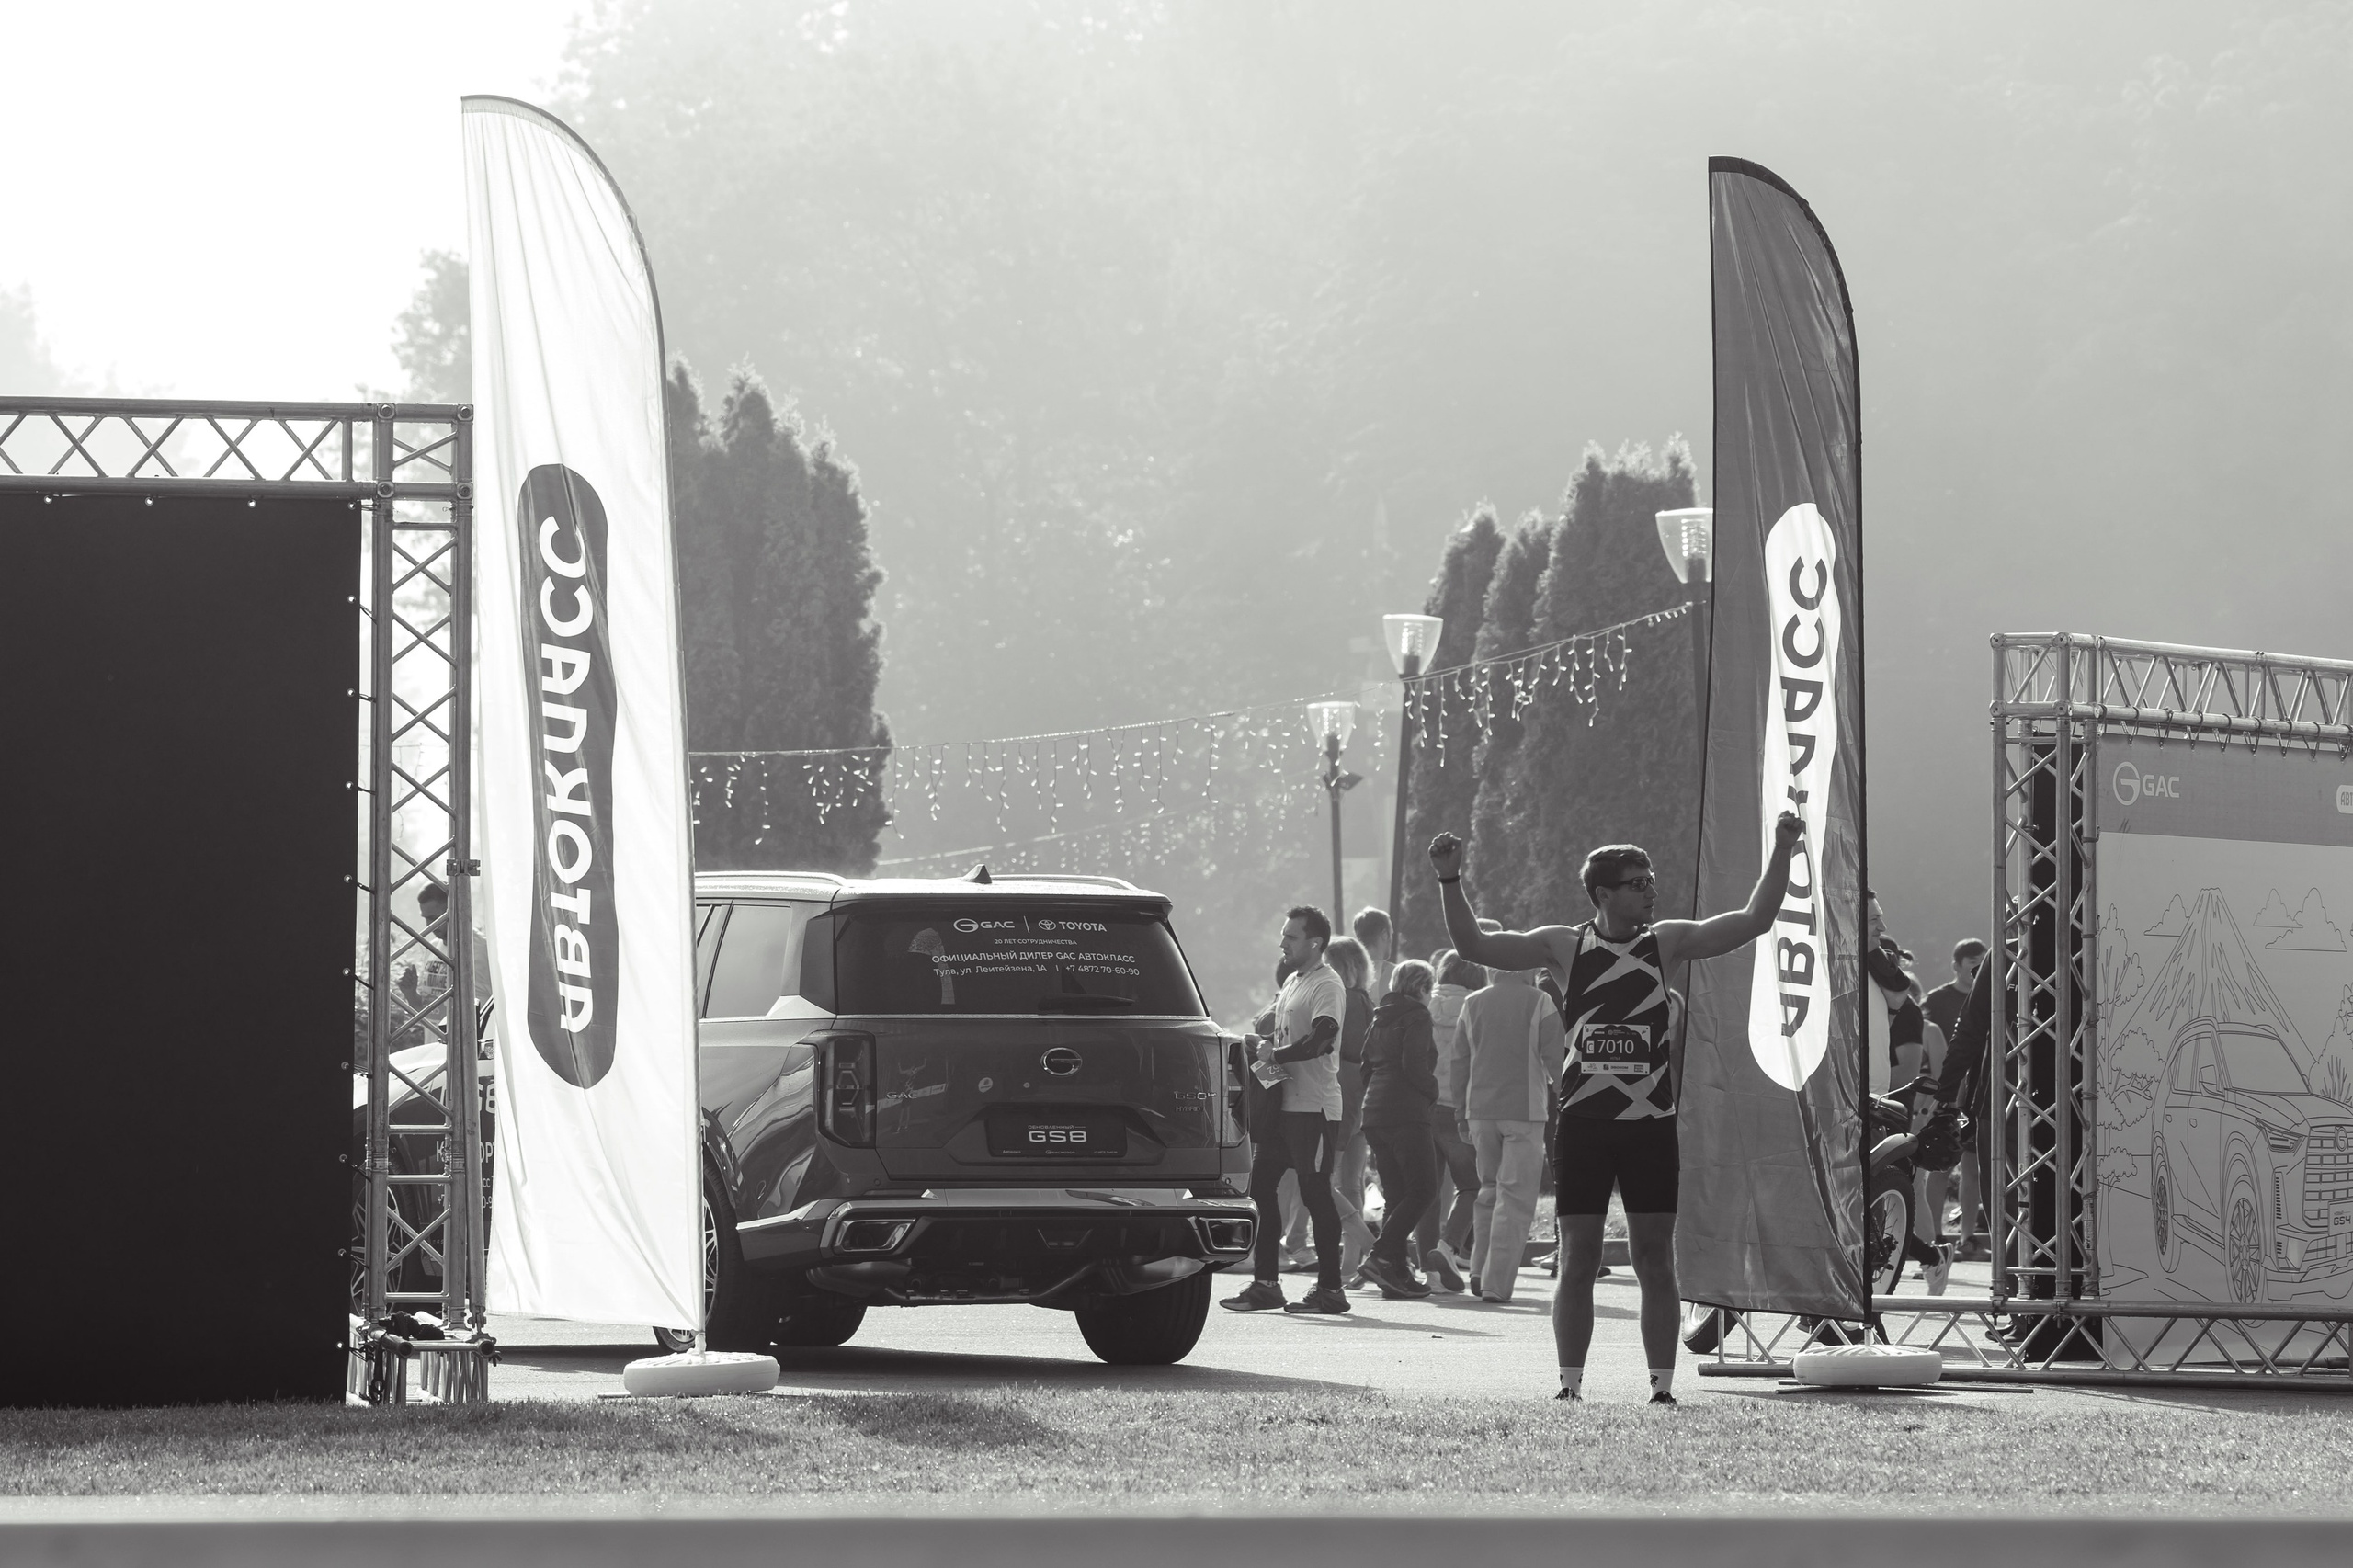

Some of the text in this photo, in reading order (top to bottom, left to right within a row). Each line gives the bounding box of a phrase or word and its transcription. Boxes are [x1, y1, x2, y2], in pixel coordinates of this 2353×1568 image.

[2143, 774, 2180, 798] GAC
[981, 921, 1015, 929] GAC
[1059, 921, 1108, 932] TOYOTA
[931, 950, 1136, 963] ОФИЦИАЛЬНЫЙ ДИЛЕР GAC АВТОКЛАСС
[933, 968, 959, 977] Тула,
[1077, 965, 1100, 973] 4872
[1100, 966, 1140, 976] 70-60-90
[1597, 1040, 1634, 1054] 7010
[886, 1091, 917, 1099] GAC
[1029, 1131, 1087, 1143] GS8
[2334, 1215, 2351, 1226] GS4
